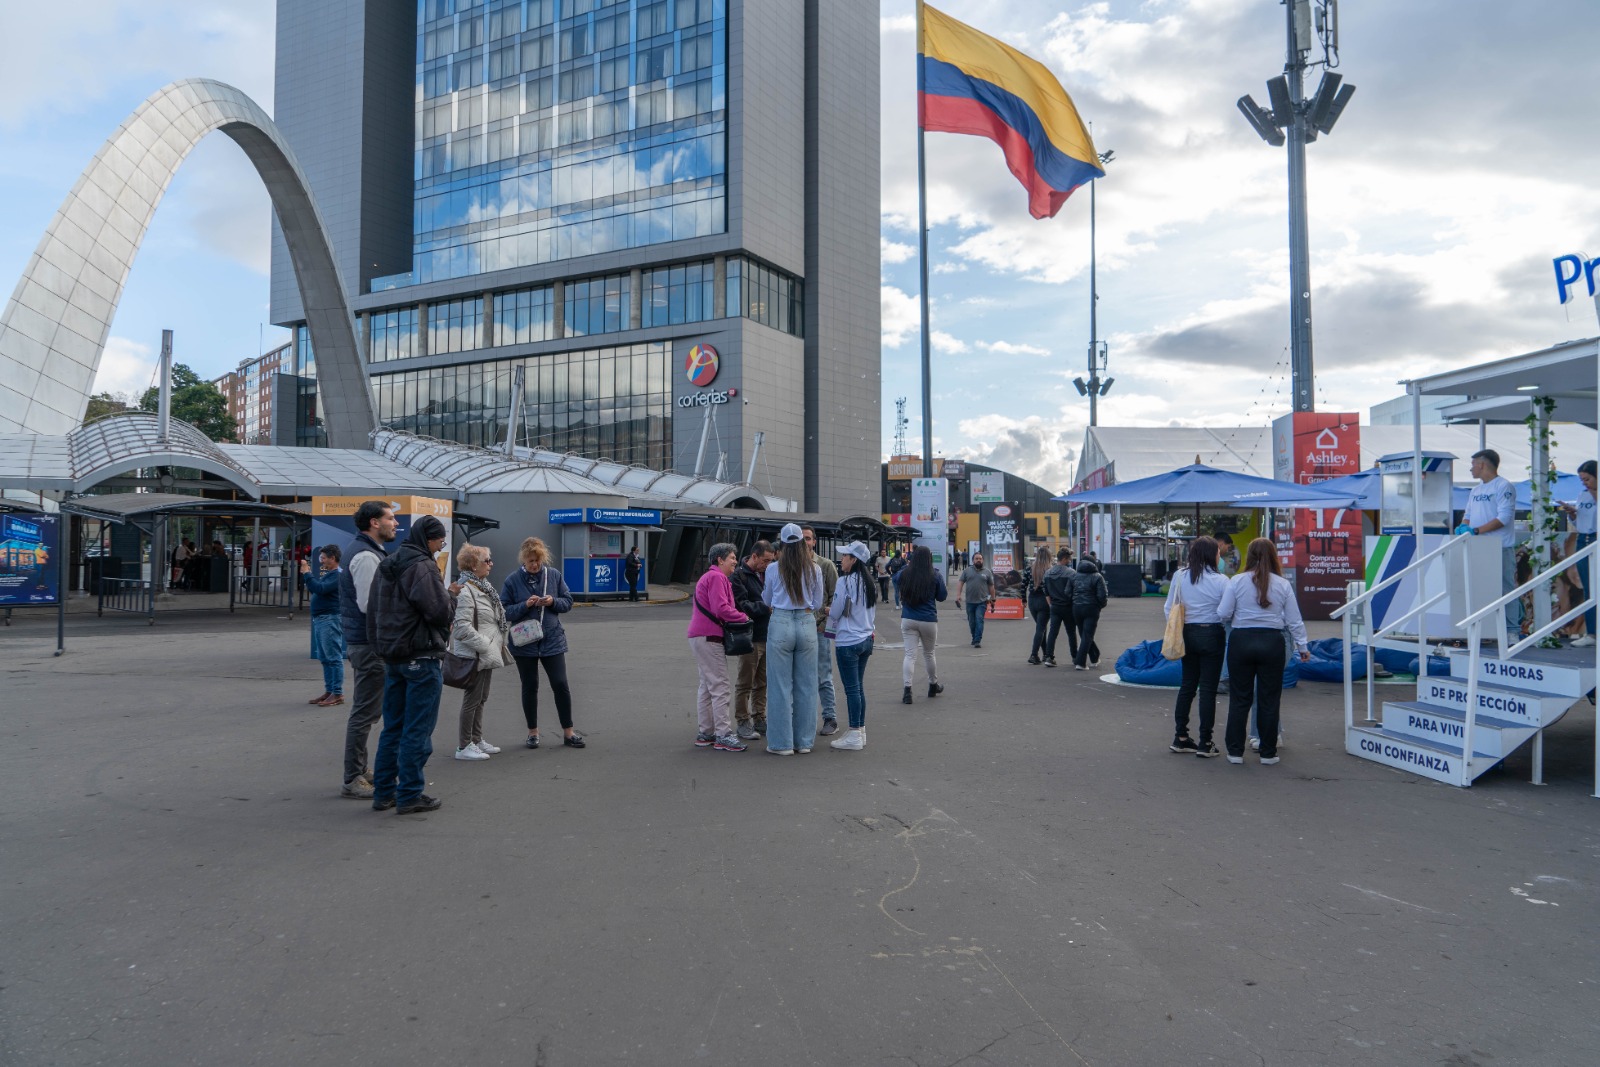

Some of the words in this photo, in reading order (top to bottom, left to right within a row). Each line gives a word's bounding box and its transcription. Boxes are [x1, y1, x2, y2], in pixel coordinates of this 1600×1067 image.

[678, 388, 728, 407] corferias
[1306, 450, 1347, 466] Ashley
[889, 463, 937, 475] GASTRONA
[1045, 516, 1052, 534] 1
[986, 534, 1019, 545] REAL
[1309, 555, 1335, 563] Compra
[1304, 567, 1325, 575] Ashley
[1484, 662, 1497, 675] 12
[1500, 665, 1544, 681] HORAS
[1431, 686, 1446, 699] DE
[1448, 689, 1526, 716] PRECCIÓN
[1408, 715, 1438, 733] PARA
[1440, 722, 1465, 739] VIVI
[1360, 738, 1382, 754] CON
[1384, 746, 1450, 774] CONFIANZA
